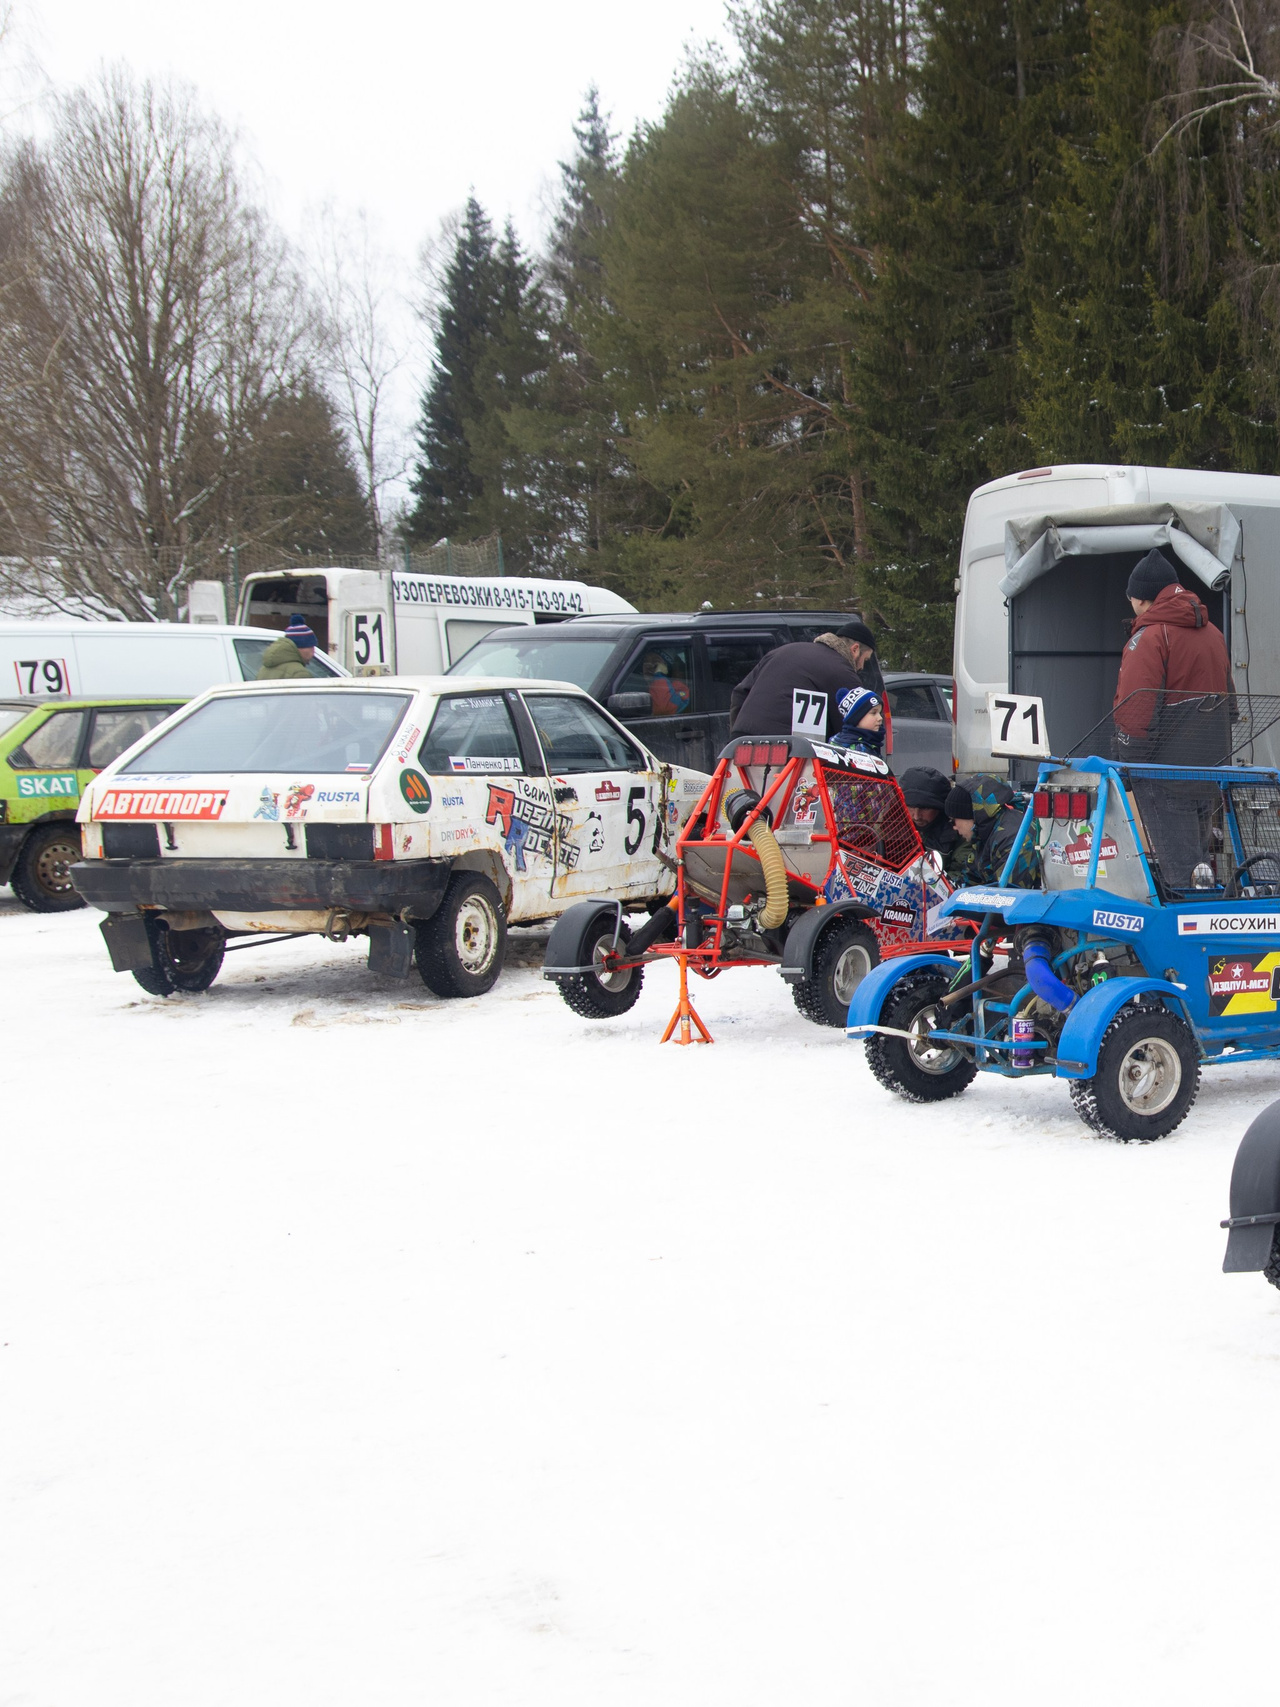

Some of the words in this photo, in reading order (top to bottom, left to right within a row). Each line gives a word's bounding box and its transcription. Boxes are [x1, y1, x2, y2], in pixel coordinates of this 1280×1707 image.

[355, 614, 385, 665] 51
[20, 660, 64, 694] 79
[795, 692, 826, 726] 77
[994, 699, 1040, 745] 71
[465, 757, 503, 770] Панченко
[19, 776, 74, 796] SKAT
[513, 778, 551, 805] Team
[97, 793, 226, 814] АВТОСПОРТ
[316, 791, 360, 802] RUSTA
[442, 796, 464, 806] RUSTA
[881, 871, 903, 888] RUSTA
[883, 908, 913, 924] KRAMAR
[1095, 911, 1144, 931] RUSTA
[1209, 917, 1277, 931] КОСУХИН
[1212, 978, 1269, 992] ДЭДПУЛ-МСК
